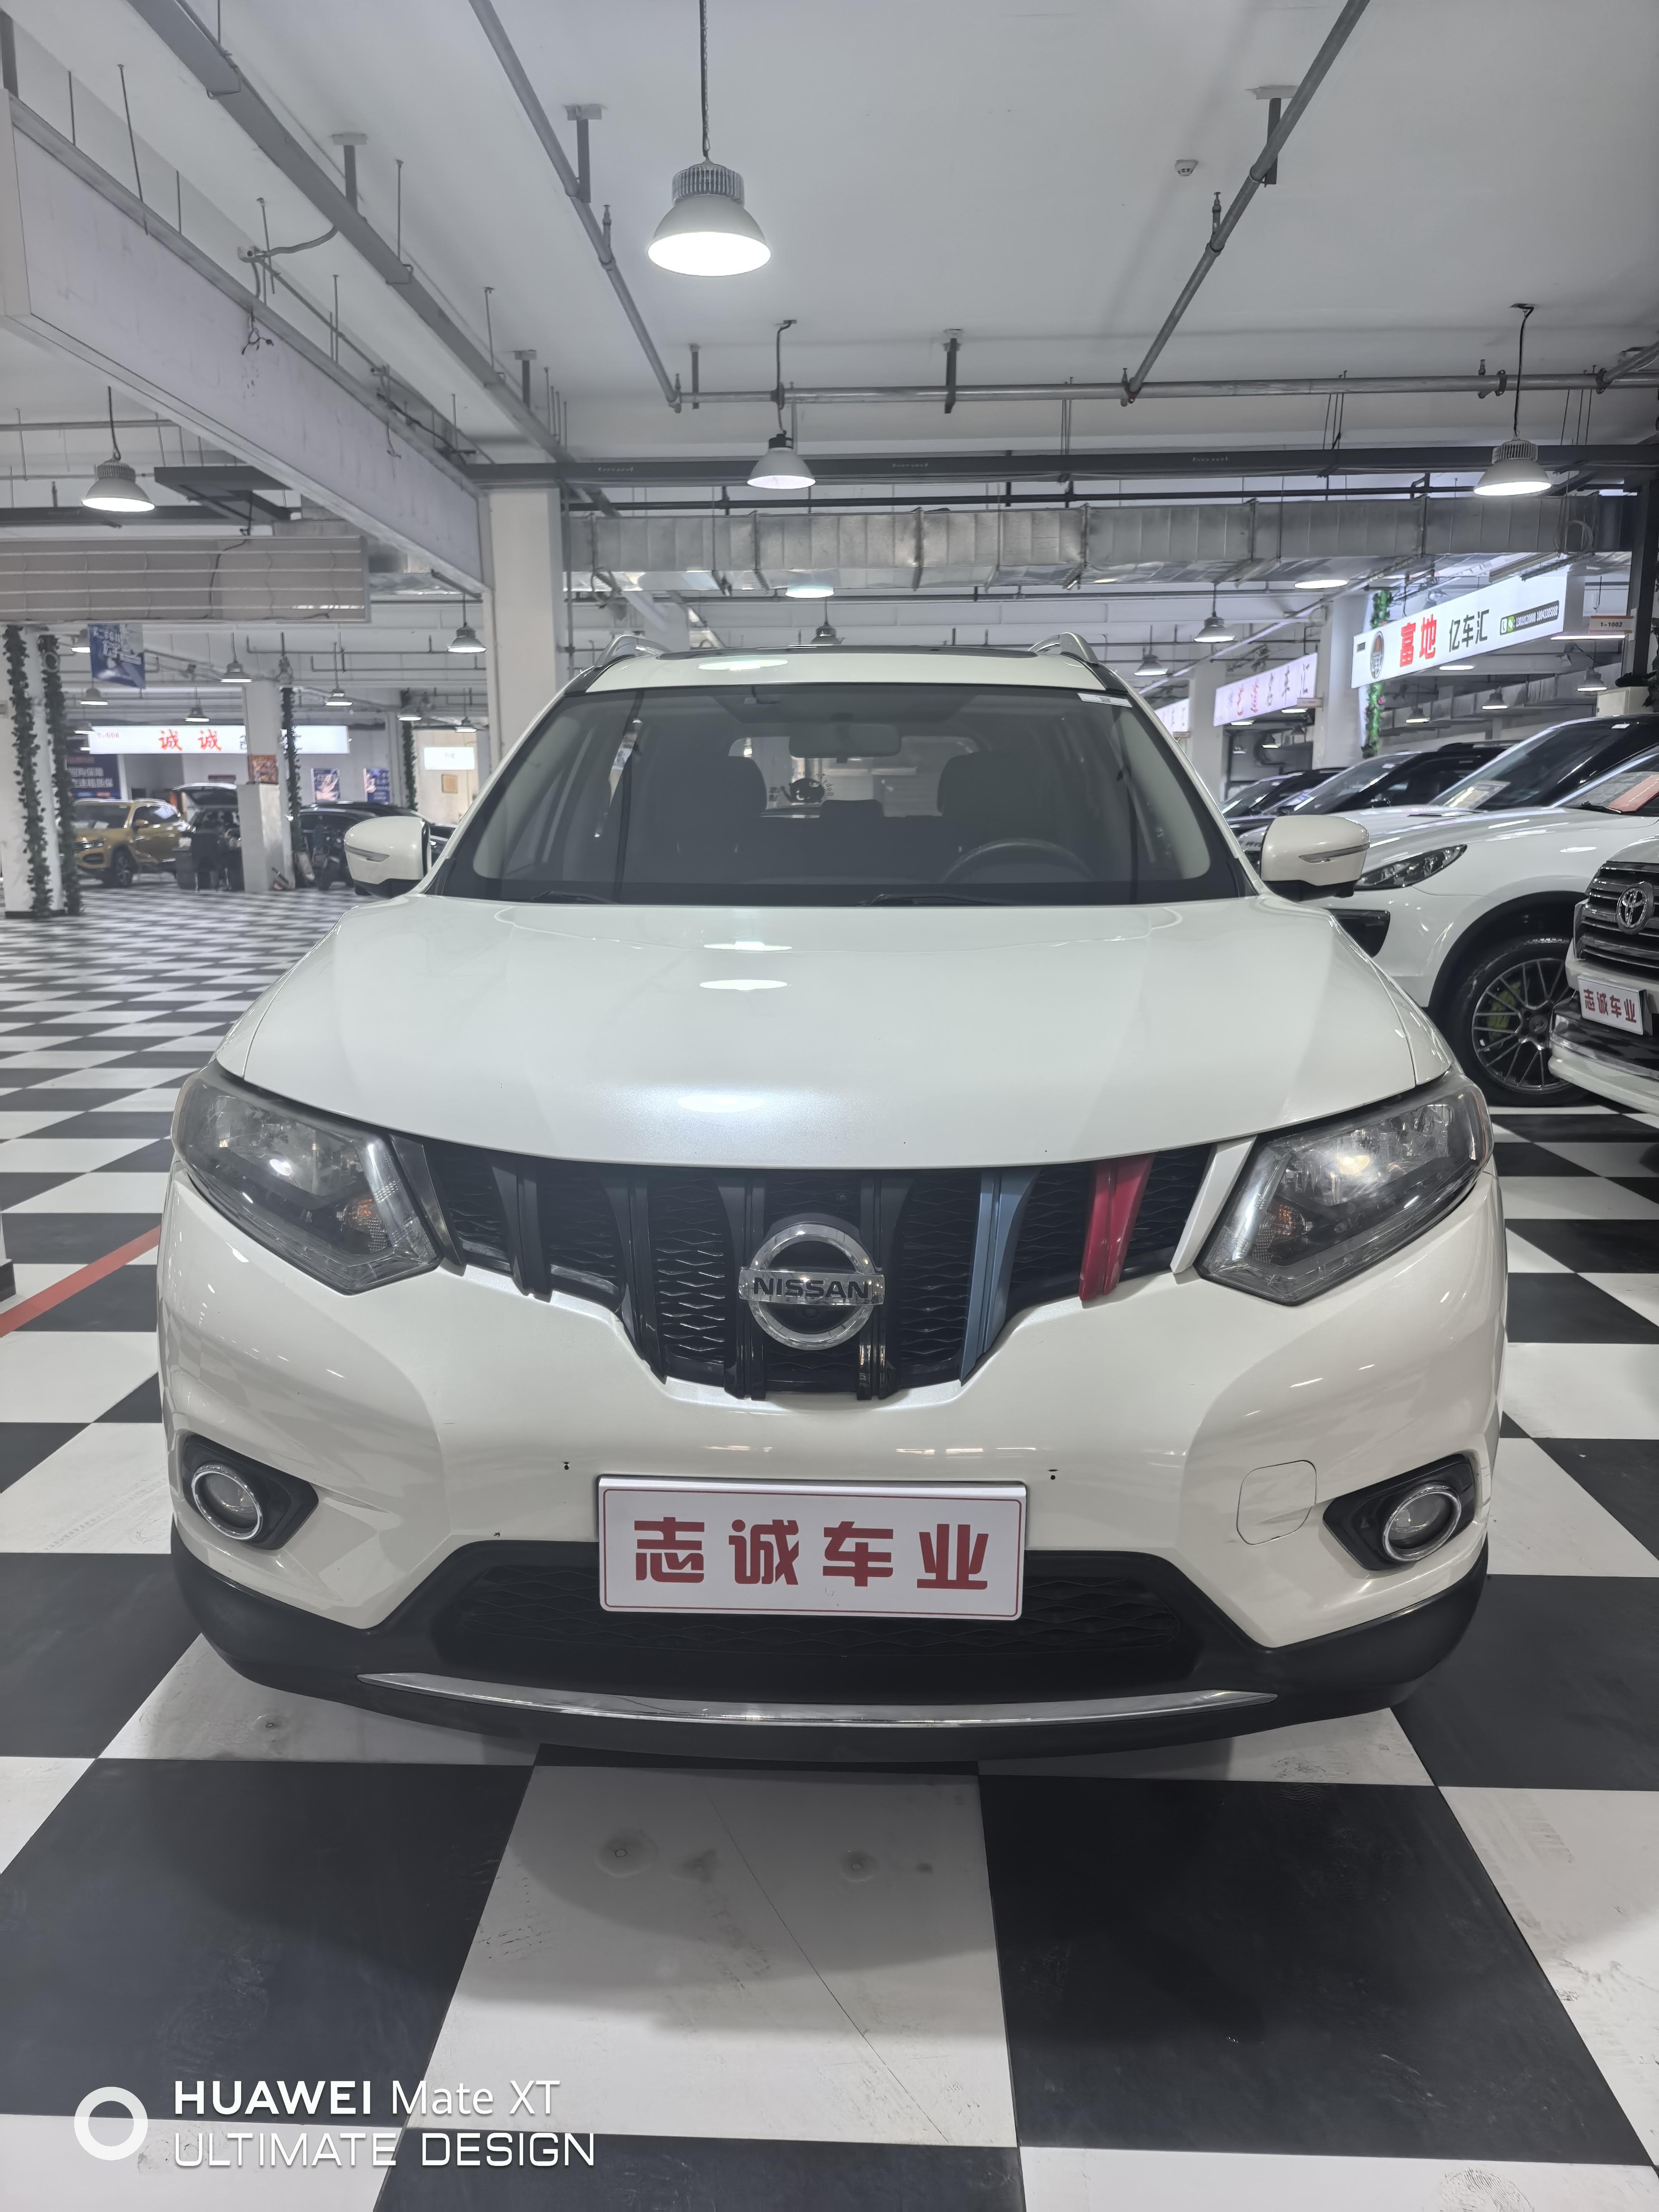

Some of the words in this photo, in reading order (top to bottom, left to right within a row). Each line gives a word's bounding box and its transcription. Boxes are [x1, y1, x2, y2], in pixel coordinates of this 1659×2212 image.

[1399, 614, 1437, 667] 富地
[1449, 609, 1490, 652] 亿车汇
[158, 729, 222, 751] 诚诚
[1583, 989, 1637, 1023] 志诚车业
[753, 1277, 868, 1298] NISSAN
[634, 1517, 989, 1590] 志诚车业
